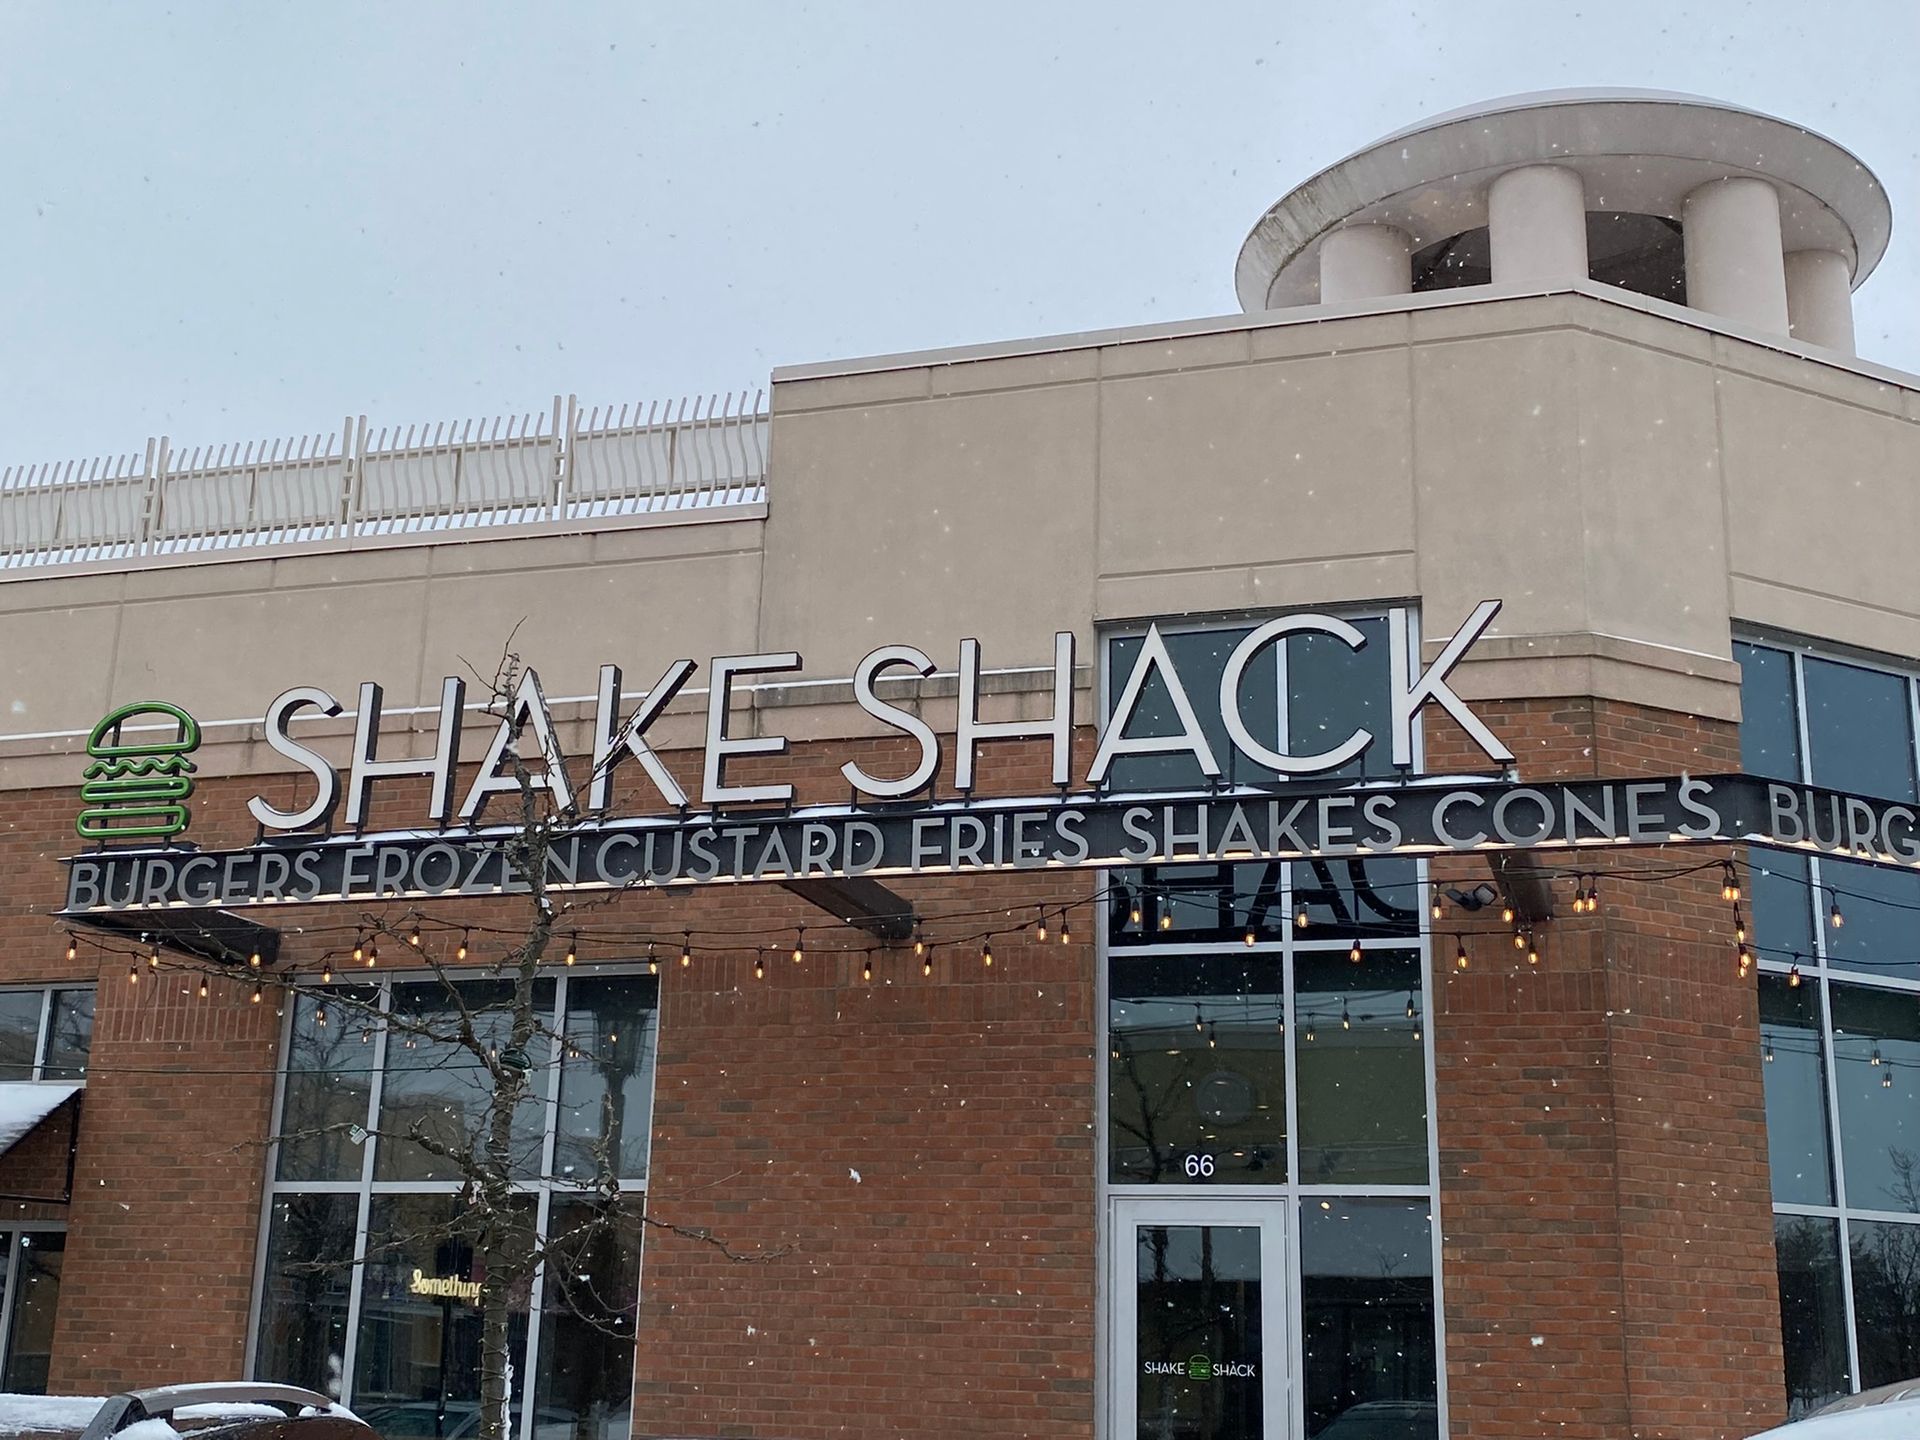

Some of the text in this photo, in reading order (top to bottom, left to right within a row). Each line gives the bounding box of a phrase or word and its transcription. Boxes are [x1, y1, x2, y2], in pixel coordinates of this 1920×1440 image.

[246, 598, 1517, 831] SHAKE SHACK
[67, 779, 1722, 912] BURGERS FROZEN CUSTARD FRIES SHAKES CONES
[1768, 783, 1920, 865] BURG
[1184, 1153, 1215, 1177] 66
[1144, 1361, 1256, 1377] SHAKE SHACK
